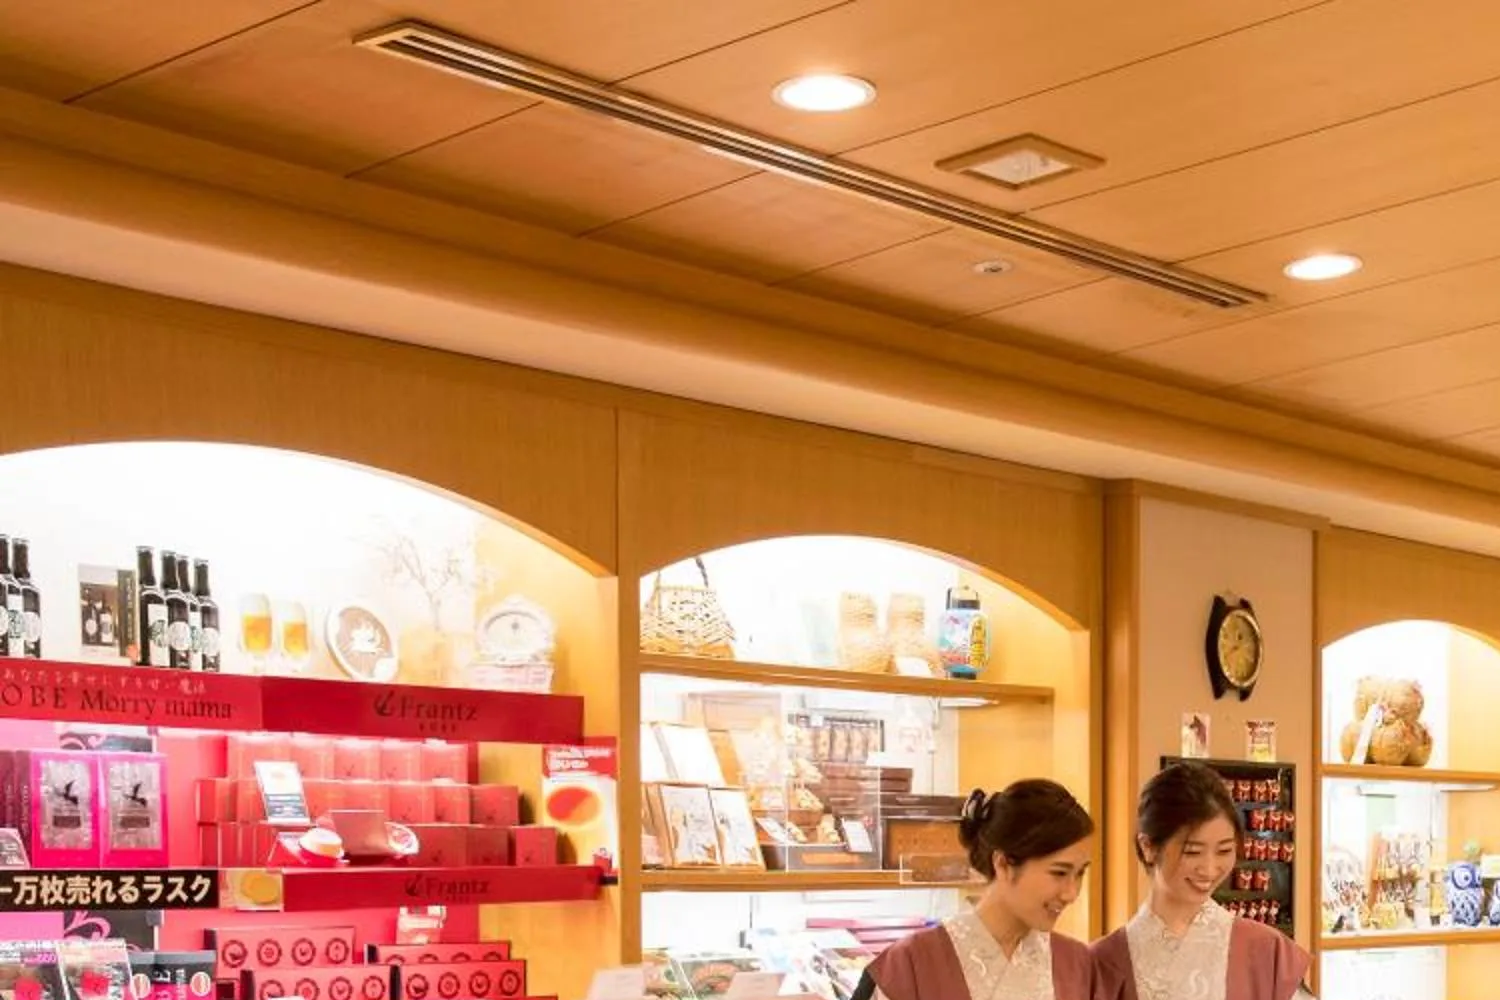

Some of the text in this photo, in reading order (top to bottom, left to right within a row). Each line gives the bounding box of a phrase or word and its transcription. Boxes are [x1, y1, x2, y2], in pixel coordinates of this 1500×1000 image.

[80, 689, 157, 720] Morry
[164, 700, 233, 719] mama
[400, 696, 478, 721] Frantz
[425, 877, 490, 896] Frantz
